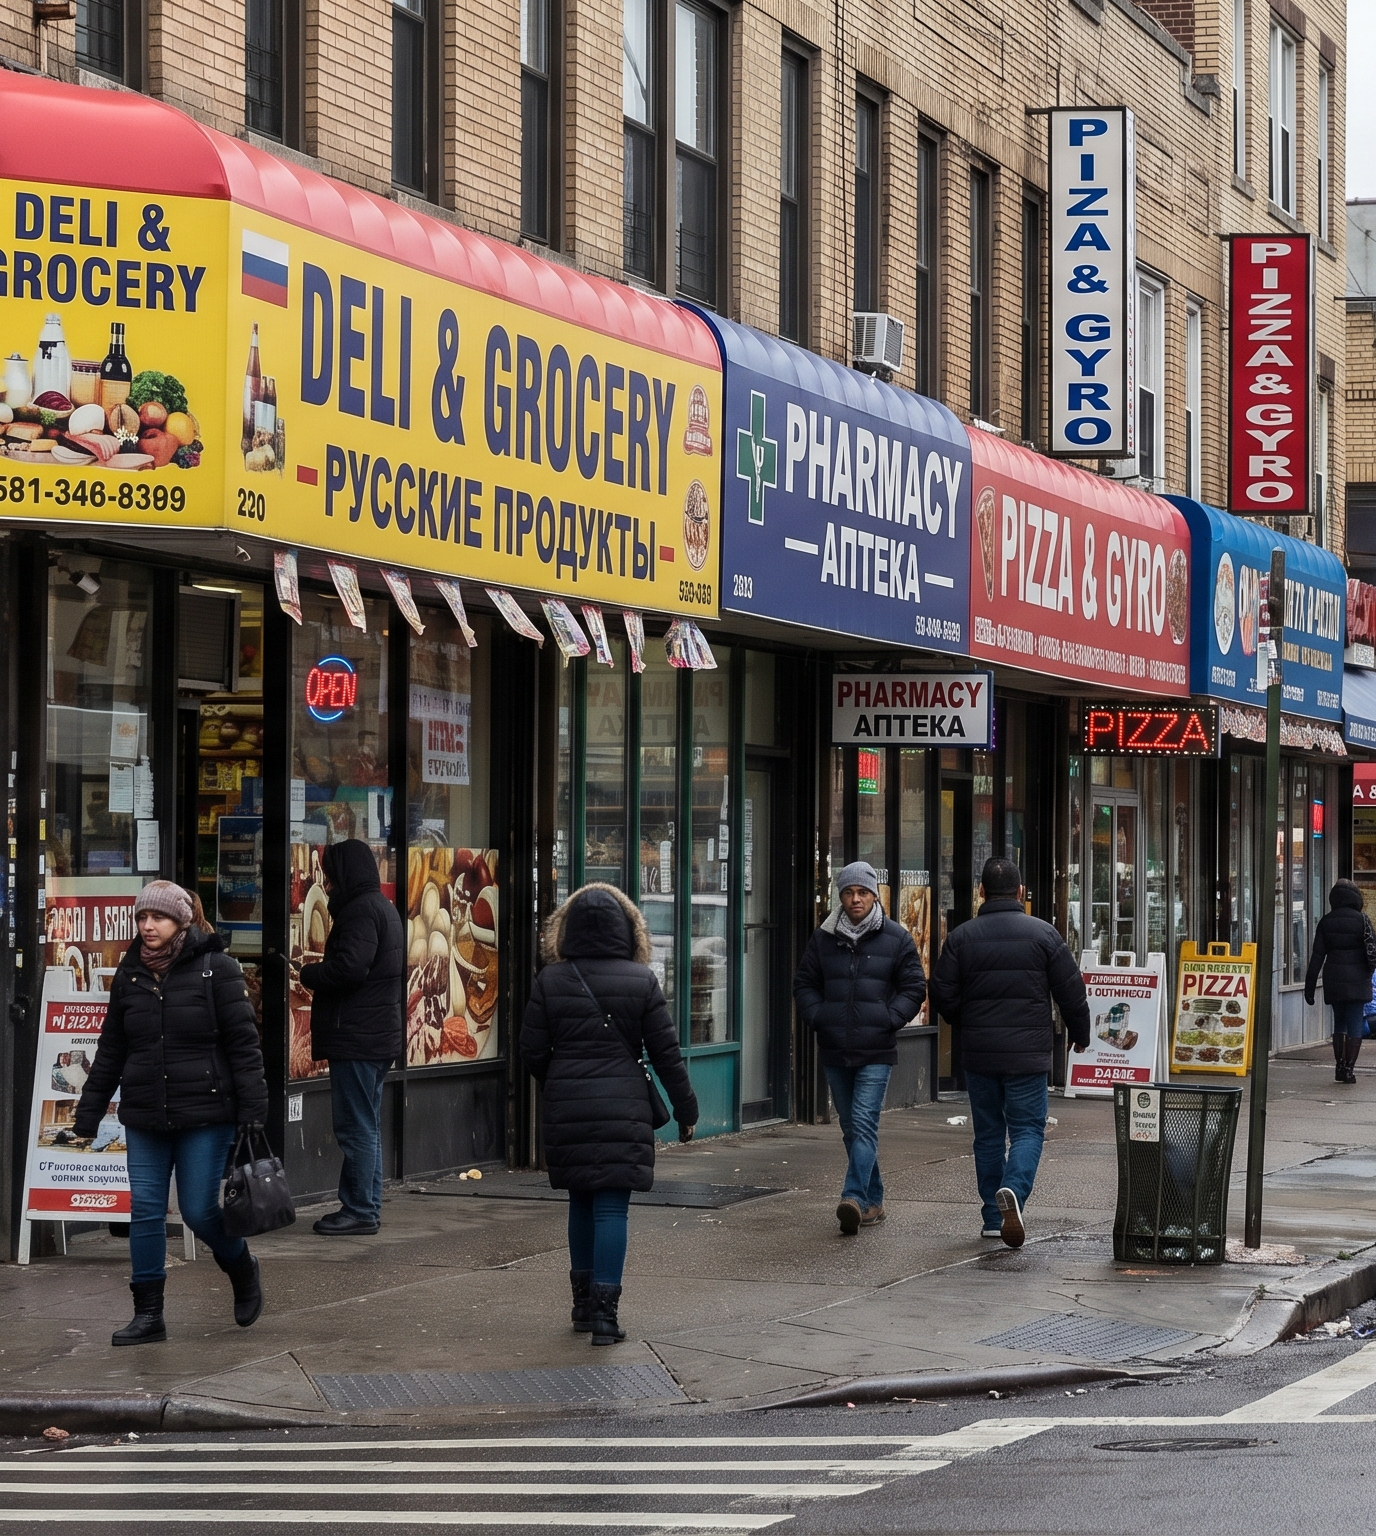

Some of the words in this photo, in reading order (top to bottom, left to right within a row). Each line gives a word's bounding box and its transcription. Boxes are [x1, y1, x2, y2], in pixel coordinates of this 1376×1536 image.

[15, 192, 118, 247] DELI
[138, 203, 172, 252] &
[0, 249, 207, 313] ROCERY
[301, 261, 412, 431] DELI
[432, 308, 466, 446] &
[484, 324, 676, 496] GROCERY
[785, 401, 963, 539] PHARMACY
[325, 443, 483, 549] РУССКИЕ
[493, 484, 656, 583] ПРОДУКТЫ
[820, 521, 921, 604] АПТЕКА
[1002, 494, 1074, 616] PIZZA
[1082, 523, 1098, 620] &
[1106, 530, 1167, 637] GYRO
[306, 667, 357, 707] OPEN
[837, 681, 983, 708] PHARMACY
[853, 714, 966, 737] АПТЕКА
[1089, 711, 1209, 750] PIZZA
[1183, 974, 1248, 998] PIZZA
